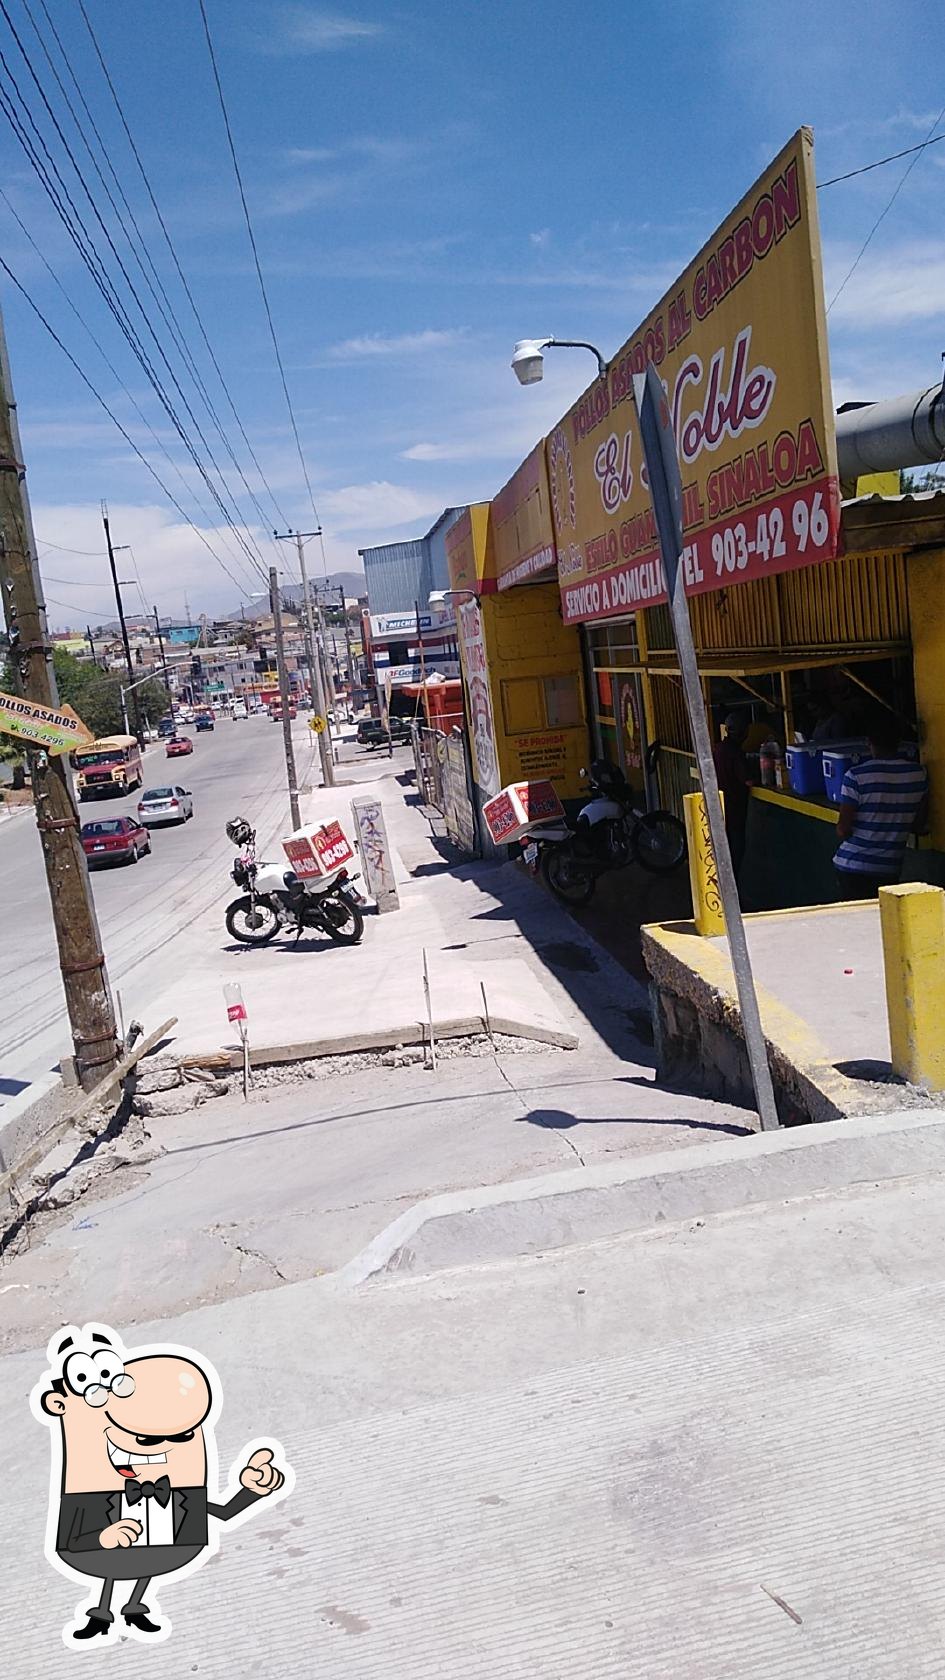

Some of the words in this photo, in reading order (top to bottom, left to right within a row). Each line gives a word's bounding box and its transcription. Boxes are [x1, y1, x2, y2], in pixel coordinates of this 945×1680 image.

[571, 378, 610, 446] POLLOS
[667, 288, 693, 354] AL
[693, 156, 801, 321] CARBON
[594, 432, 632, 514] El
[707, 418, 825, 520] SINALOA
[565, 582, 600, 618] SERVICIO
[602, 580, 611, 610] A
[711, 507, 787, 577] 903-42
[792, 492, 829, 553] 96
[32, 709, 77, 730] ASADOS
